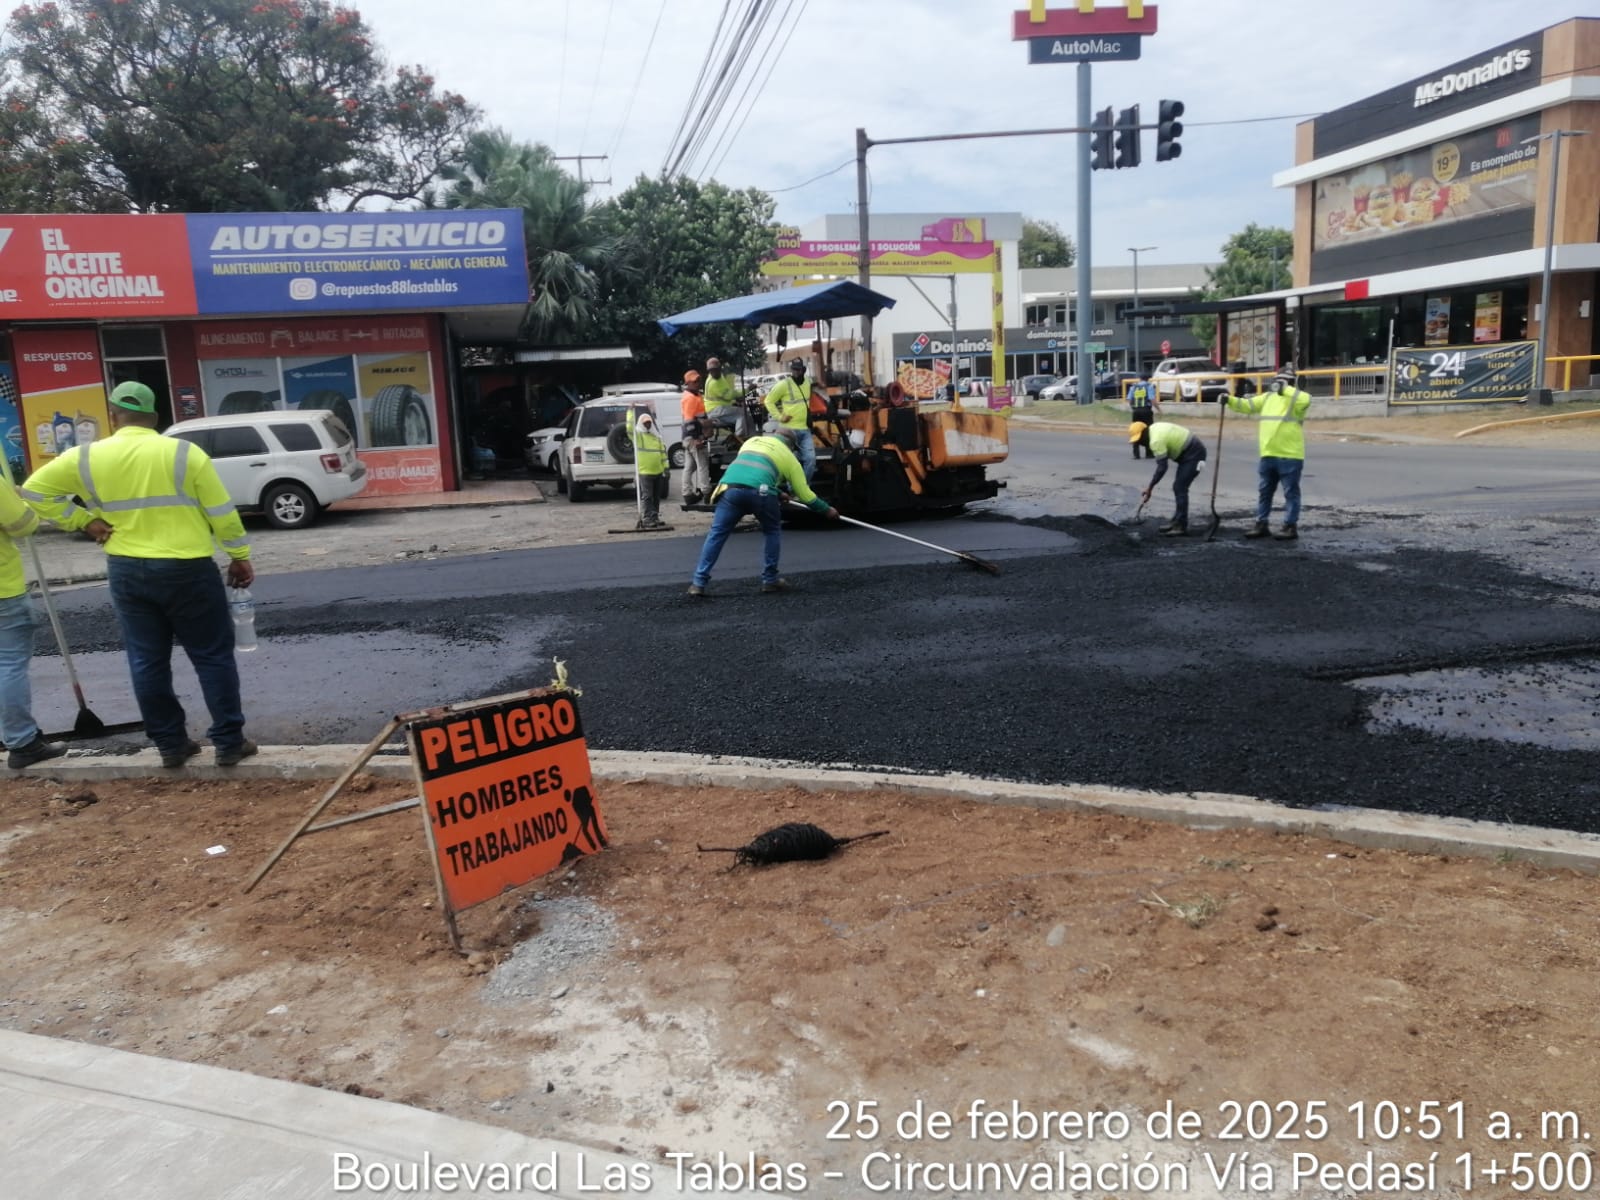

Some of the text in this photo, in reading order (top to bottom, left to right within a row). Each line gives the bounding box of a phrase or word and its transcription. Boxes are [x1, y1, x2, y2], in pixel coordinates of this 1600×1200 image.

[1051, 39, 1121, 55] AutoMac
[1414, 49, 1531, 108] McDonald's
[1470, 145, 1537, 172] Es momento de
[41, 228, 70, 250] EL
[210, 220, 506, 251] AUTOSERVICIO
[817, 243, 862, 252] PROBLEMA
[877, 241, 920, 251] SOLUCIÓN
[45, 252, 123, 275] ACEITE
[213, 261, 301, 275] MANTENIMIENTO
[304, 257, 401, 273] ELECTROMECÁNICO
[410, 256, 461, 270] MECÁNICA
[464, 255, 508, 269] GENERAL
[45, 275, 164, 299] ORIGINAL
[321, 278, 458, 298] @repuestos88lastablas
[200, 332, 265, 345] ALINEAMIENTO
[298, 329, 338, 342] BALANCE
[24, 352, 94, 362] RESPUESTOS
[54, 363, 67, 372] 88
[1430, 352, 1464, 377] 24
[1430, 377, 1464, 386] abierto
[1400, 390, 1457, 400] AUTOMAC
[421, 699, 576, 771] PELIGRO
[436, 765, 563, 828] HOMBRES
[446, 807, 568, 876] TRABAJANDO
